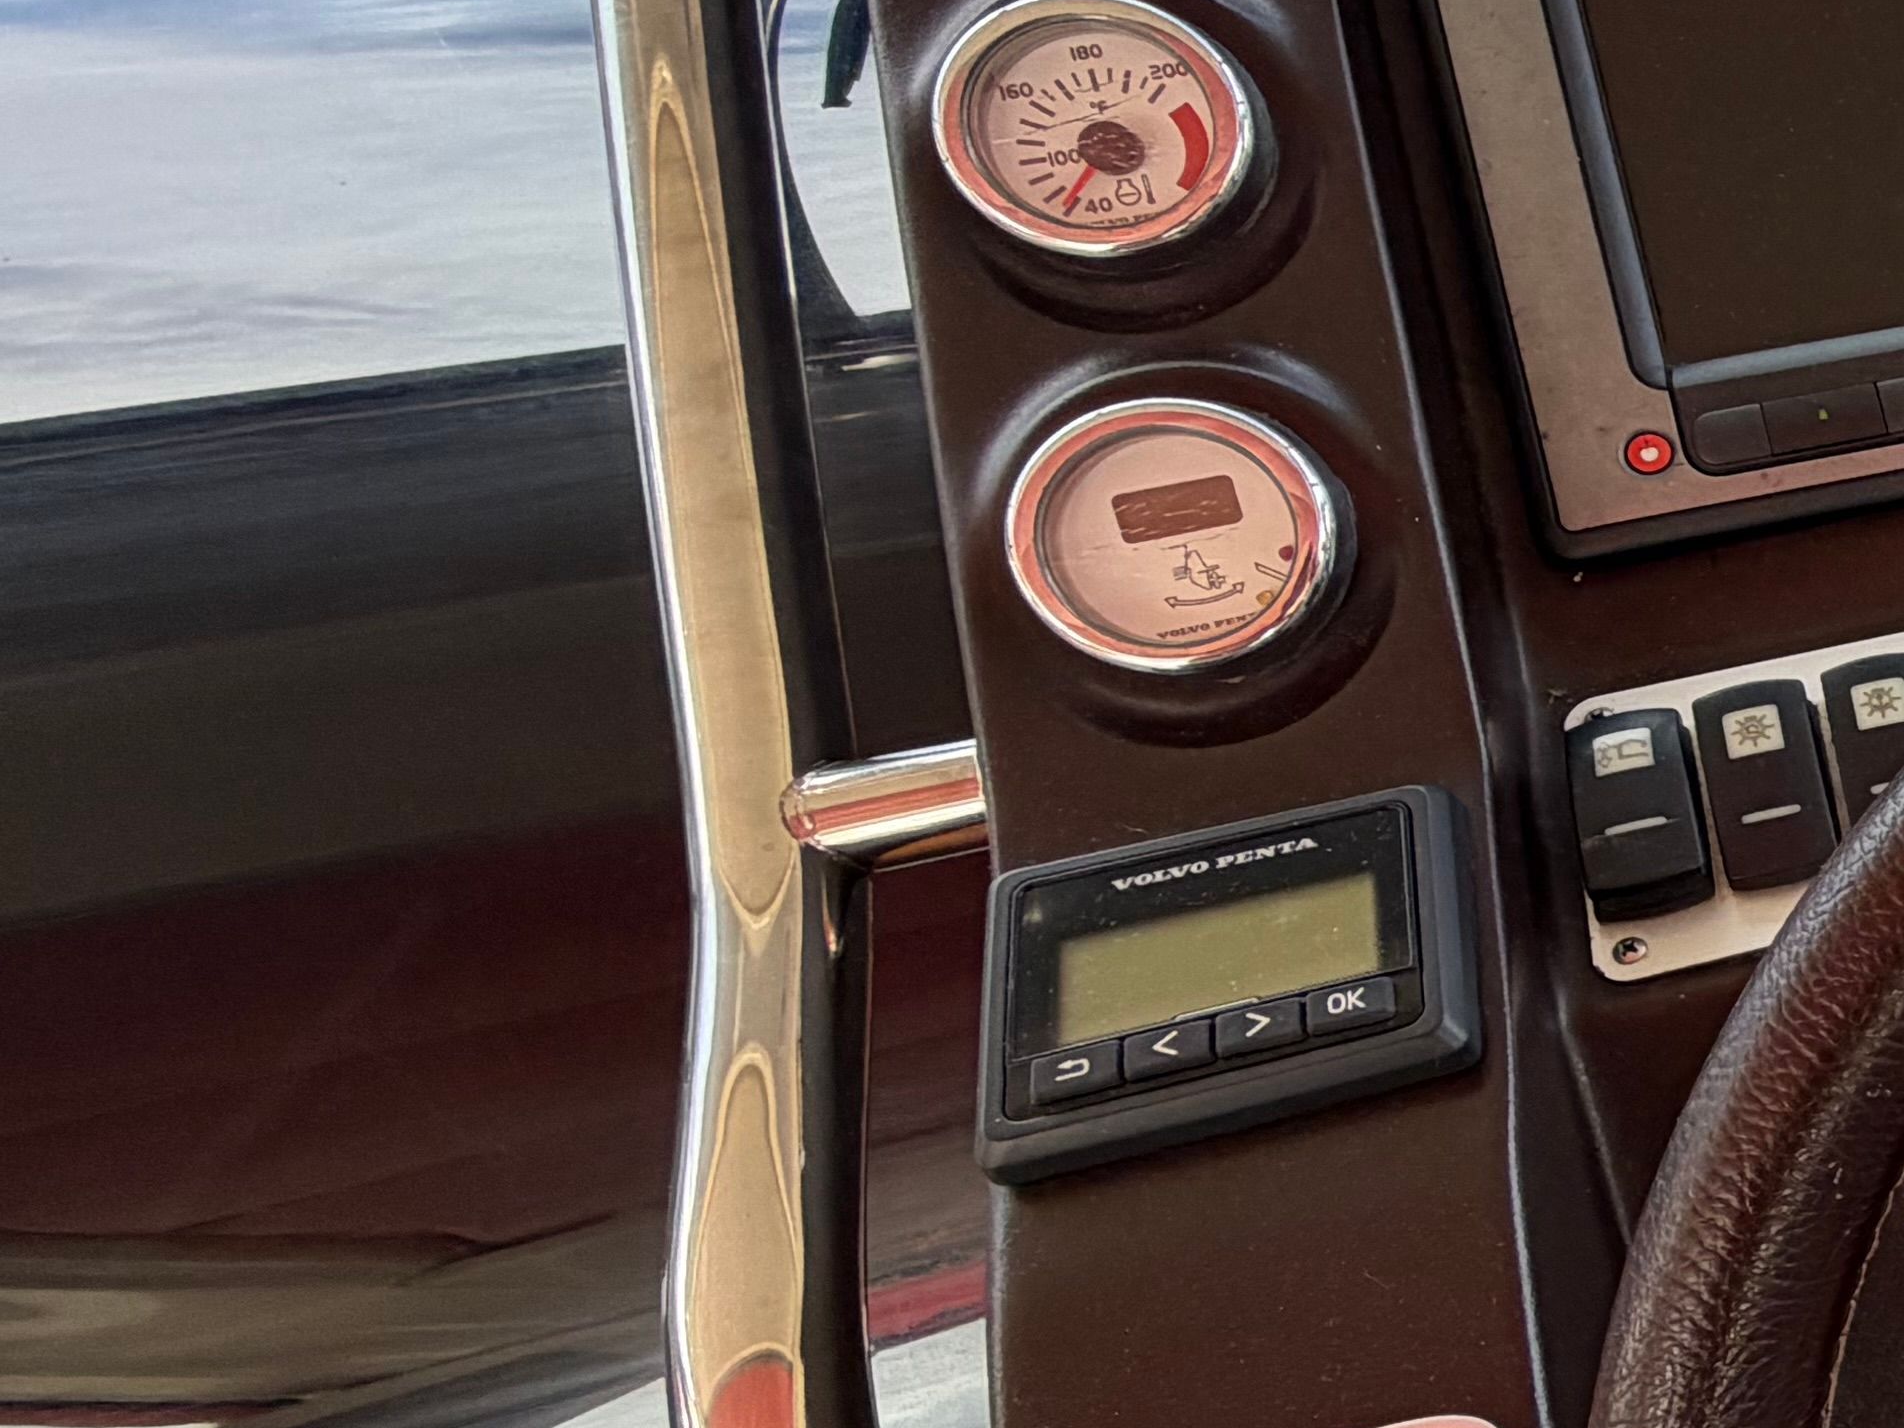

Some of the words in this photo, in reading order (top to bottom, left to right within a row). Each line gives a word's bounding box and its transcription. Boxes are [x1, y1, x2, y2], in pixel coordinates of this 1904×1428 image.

[1069, 43, 1103, 62] 180
[1149, 64, 1189, 81] 200
[999, 82, 1034, 101] 160
[1046, 151, 1081, 167] 100
[1084, 197, 1114, 214] 40
[1157, 622, 1211, 640] VOLVO
[1111, 861, 1209, 891] VOLVO
[1215, 837, 1319, 871] PENTA
[1327, 987, 1366, 1016] OK
